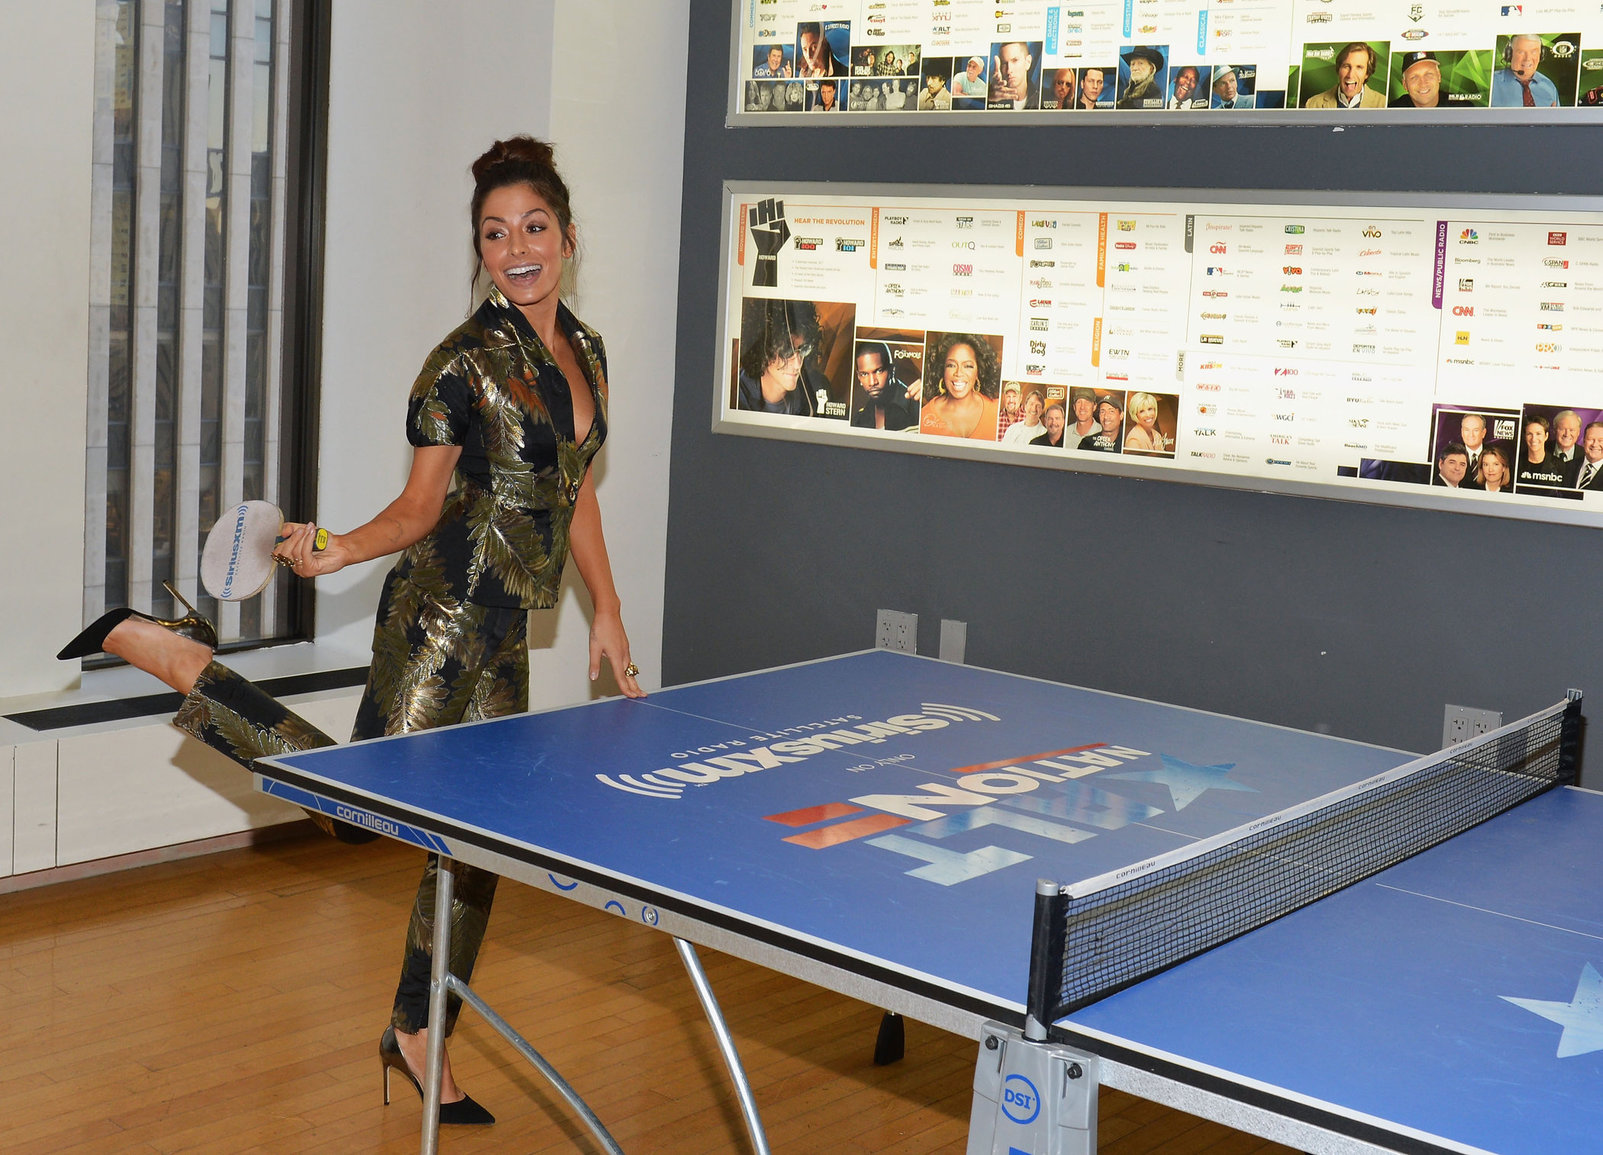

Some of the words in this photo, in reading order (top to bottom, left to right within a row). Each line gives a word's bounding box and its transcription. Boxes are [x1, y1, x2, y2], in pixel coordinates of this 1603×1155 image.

[952, 264, 973, 273] COSMO
[1434, 248, 1444, 298] NEWS/PUBLIC
[1452, 306, 1474, 316] CNN
[1030, 340, 1046, 350] Dirty
[1031, 346, 1046, 356] Dog
[826, 408, 846, 416] STERN
[1532, 473, 1563, 482] msnbc
[750, 714, 863, 742] SATELLITE
[654, 714, 950, 784] siriusxm
[670, 740, 747, 759] RADIO
[846, 764, 875, 772] ON
[874, 754, 916, 766] ONLY
[848, 744, 1152, 820] NATION
[336, 806, 400, 837] cornilleau
[1248, 814, 1282, 831] cornilleau
[1115, 860, 1156, 880] cornilleau
[1004, 1088, 1031, 1110] DSI
